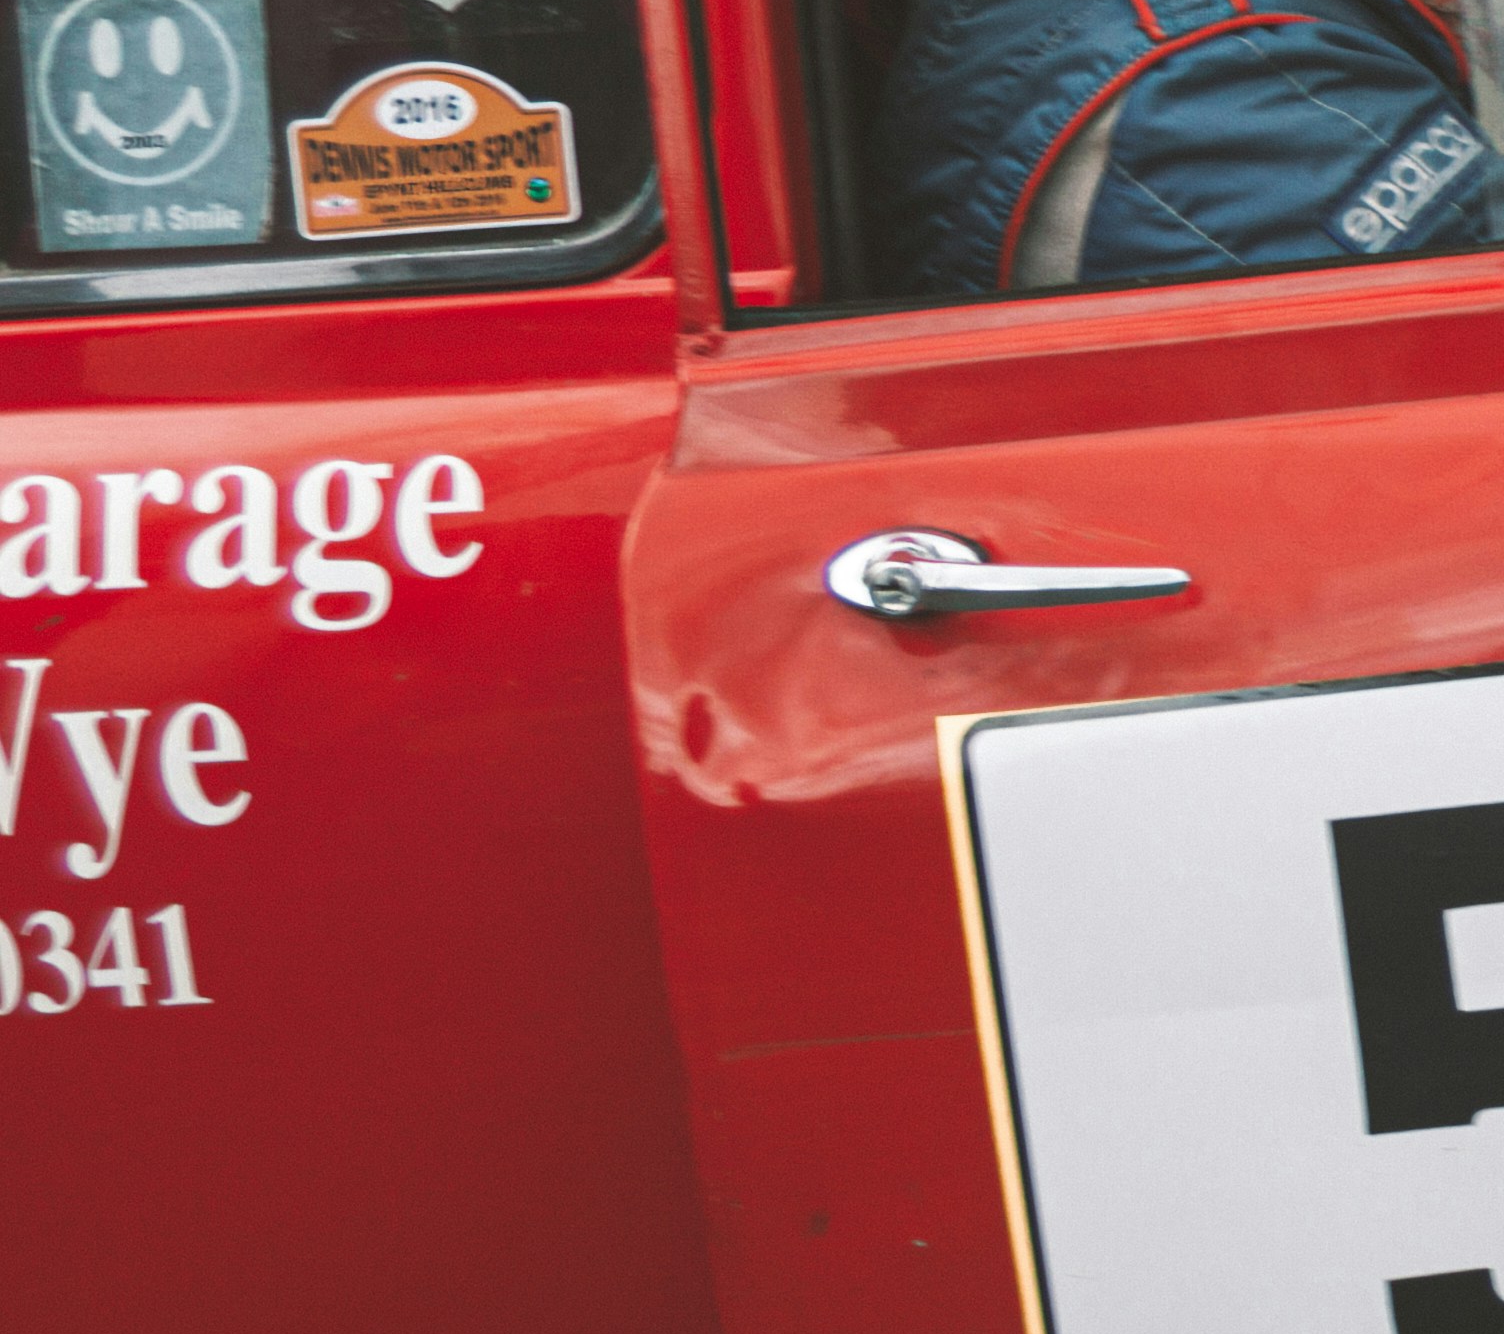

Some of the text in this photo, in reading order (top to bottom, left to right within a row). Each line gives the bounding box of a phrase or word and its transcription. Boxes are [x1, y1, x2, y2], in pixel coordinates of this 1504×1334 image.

[392, 94, 462, 125] 2016
[304, 120, 558, 185] DENNIS MOTOR SPORT
[61, 202, 245, 236] Show A Smile
[0, 454, 485, 632] arage
